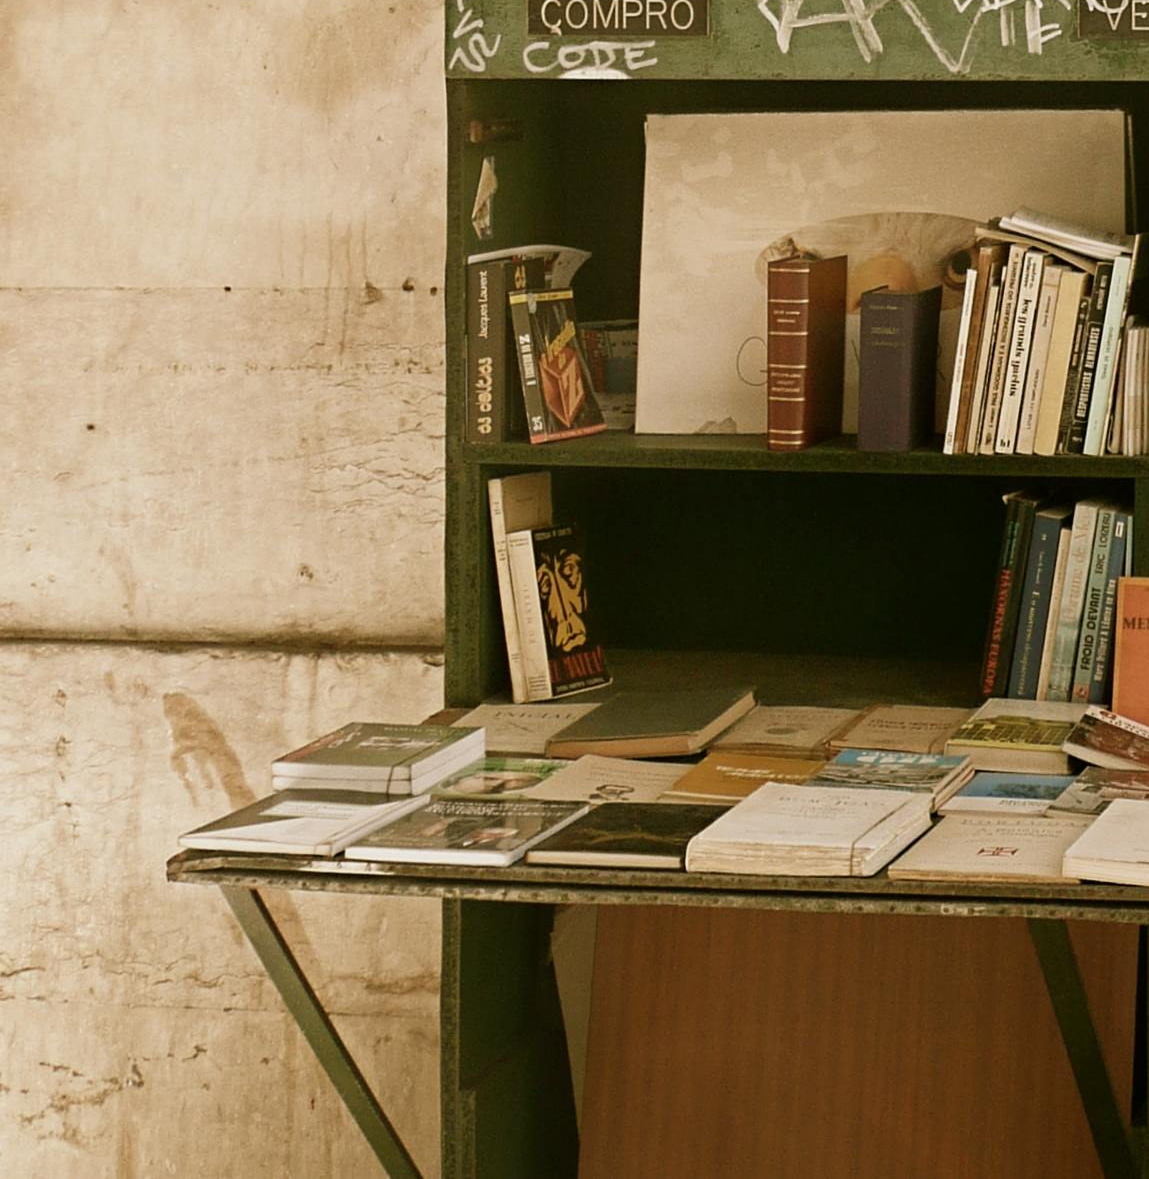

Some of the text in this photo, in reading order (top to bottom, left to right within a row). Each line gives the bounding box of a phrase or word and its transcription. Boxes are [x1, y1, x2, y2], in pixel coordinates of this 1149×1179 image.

[479, 270, 487, 302] Laurent
[1008, 299, 1032, 397] les grands yachts
[1081, 588, 1101, 670] FROID DEVANT
